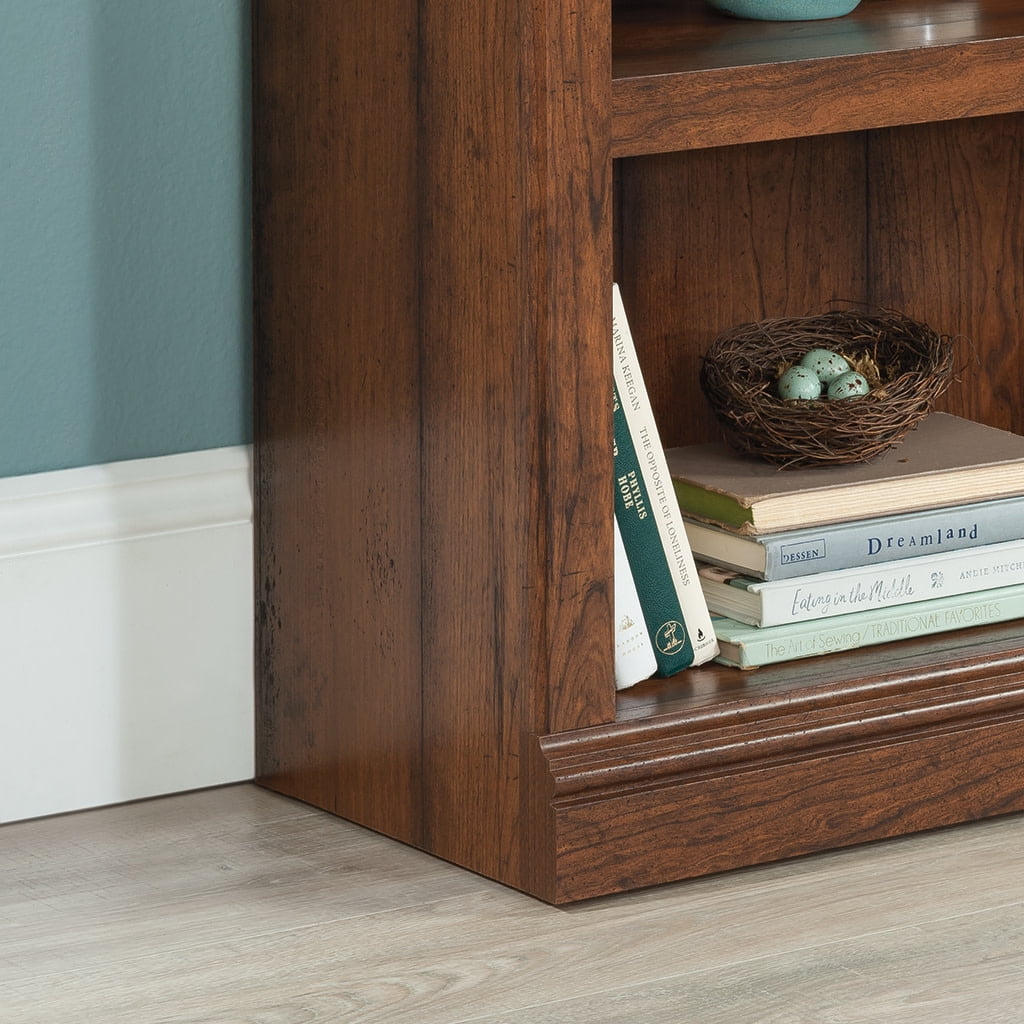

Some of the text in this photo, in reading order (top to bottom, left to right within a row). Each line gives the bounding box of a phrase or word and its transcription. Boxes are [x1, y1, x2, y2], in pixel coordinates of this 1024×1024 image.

[622, 365, 640, 412] KEEGAN
[618, 475, 634, 510] HOBE
[627, 470, 648, 520] PHYLLIS
[639, 426, 691, 587] THE OPPOSITE OF LONELINESS
[783, 549, 819, 562] DESSEN
[791, 588, 831, 615] Eating
[834, 592, 846, 605] in
[848, 582, 867, 604] the
[869, 574, 914, 602] Middle
[959, 568, 989, 580] ANDIE
[766, 643, 785, 657] The
[788, 638, 802, 654] Art
[806, 638, 817, 652] of
[819, 631, 861, 650] Sewing
[871, 613, 941, 638] TRADITIONAL
[944, 602, 1002, 625] FAVORITES
